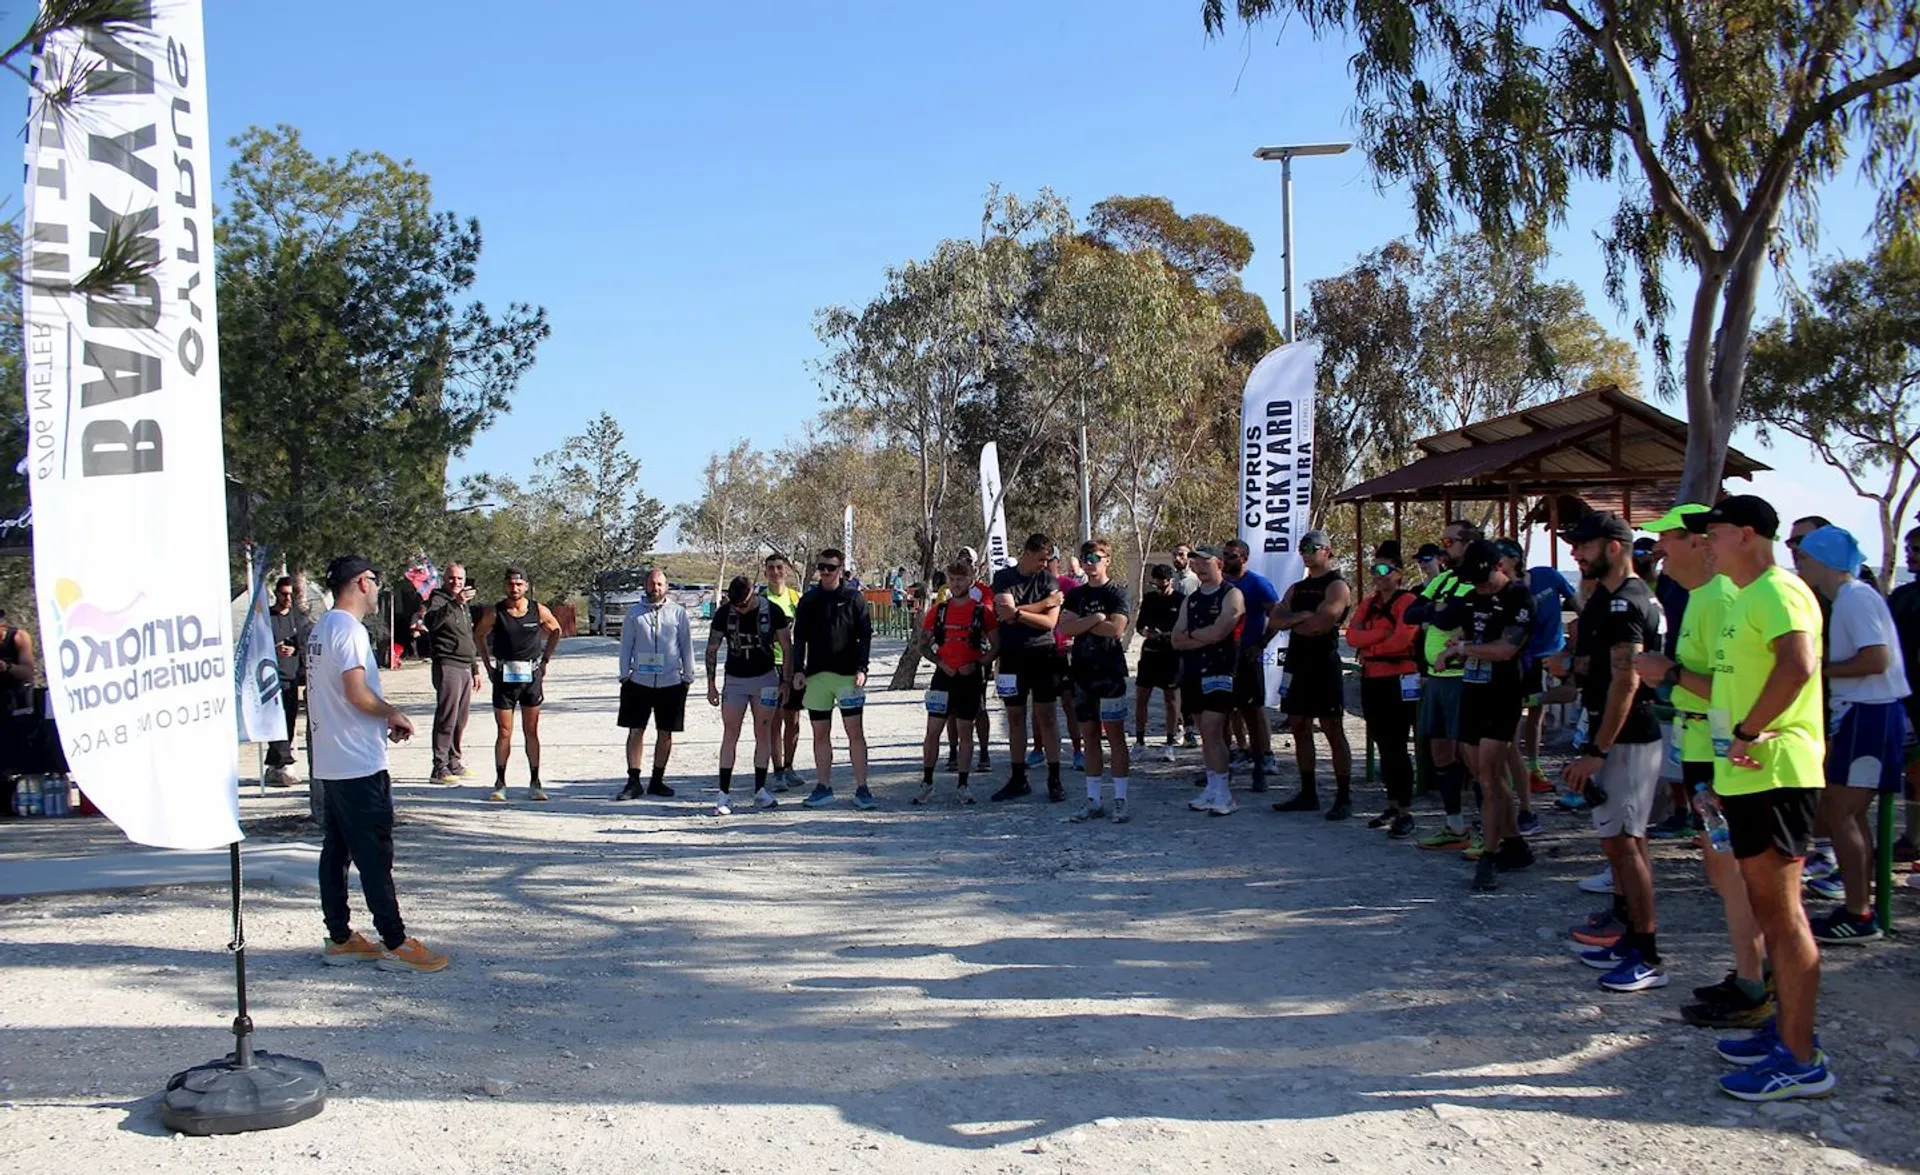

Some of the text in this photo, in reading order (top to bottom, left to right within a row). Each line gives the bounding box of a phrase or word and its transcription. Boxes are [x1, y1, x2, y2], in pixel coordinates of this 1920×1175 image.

[1245, 426, 1262, 528] CYPRUS
[1264, 400, 1293, 553] BACKYARD
[1296, 442, 1312, 505] ULTRA
